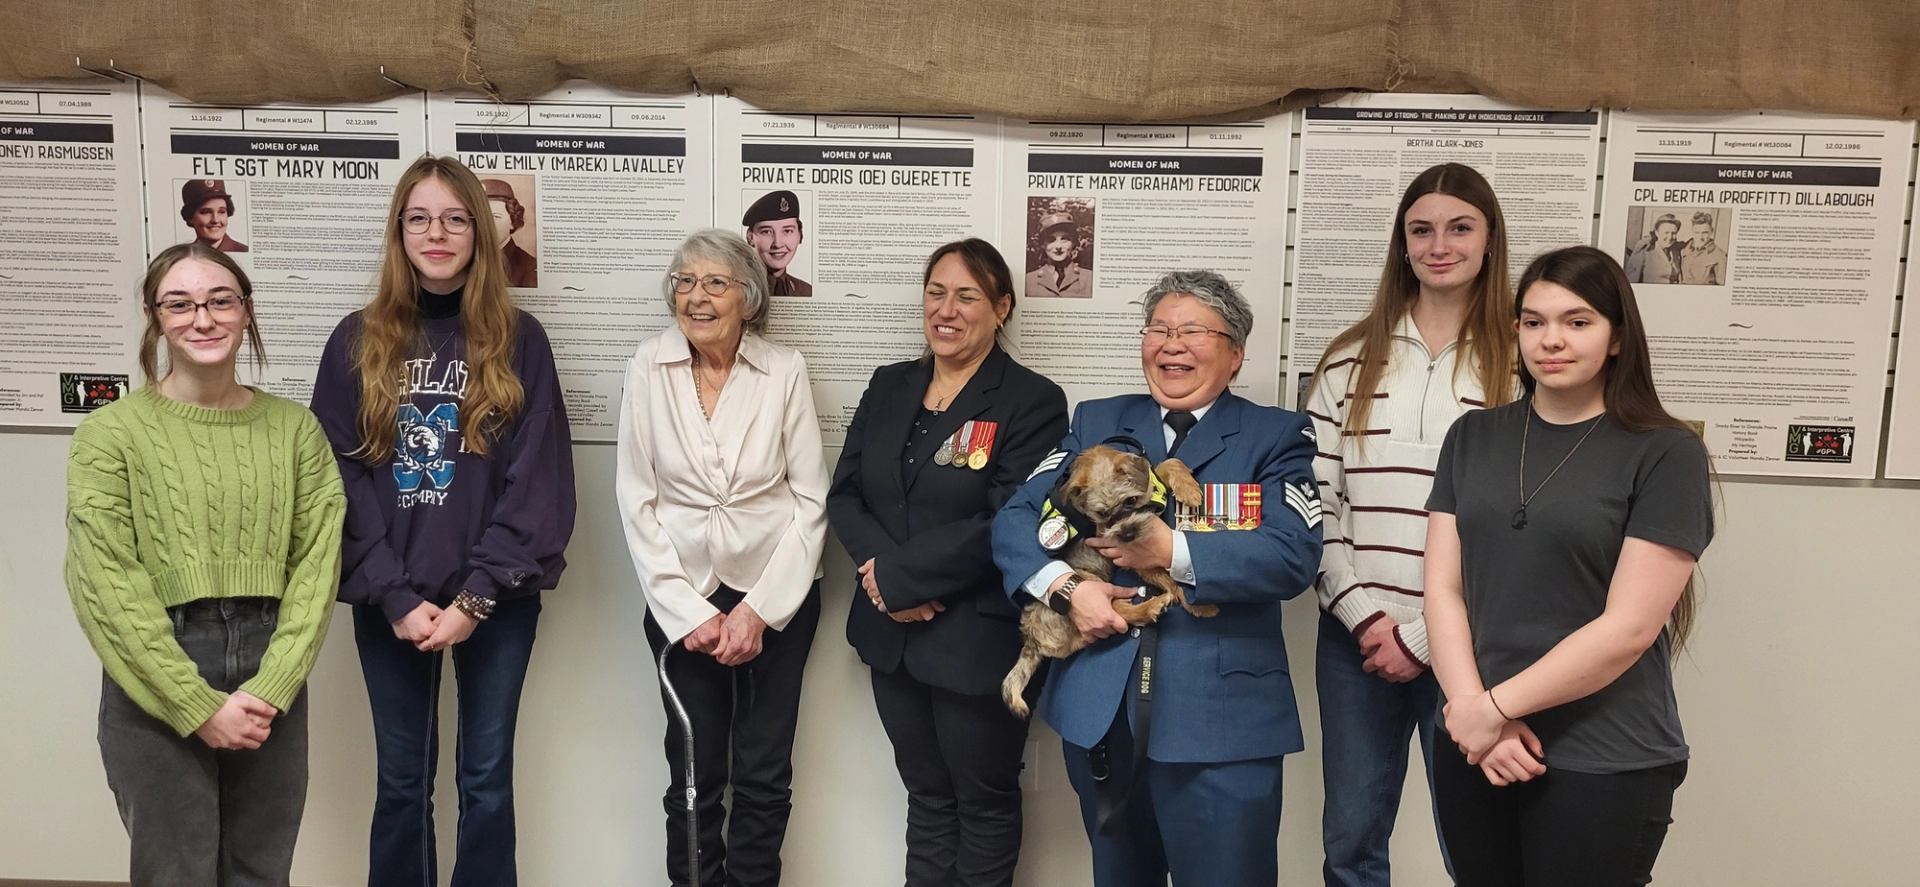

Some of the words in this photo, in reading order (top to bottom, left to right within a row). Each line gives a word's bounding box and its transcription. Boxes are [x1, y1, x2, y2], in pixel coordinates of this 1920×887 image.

[256, 116, 286, 124] Regimental
[1434, 112, 1456, 120] MAKING
[1514, 114, 1544, 122] ADVOCATE
[1, 127, 12, 135] OF
[15, 127, 34, 136] WAR
[1116, 132, 1148, 140] Regimental
[250, 142, 284, 151] WOMEN
[286, 143, 298, 151] OF
[300, 144, 320, 152] WAR
[536, 140, 570, 148] WOMEN
[586, 141, 606, 149] WAR
[1406, 139, 1434, 148] BERTHA
[1436, 140, 1484, 148] CLARK-JONES
[39, 146, 114, 160] RASMUSSEN
[822, 151, 856, 159] WOMEN
[858, 152, 870, 160] OF
[872, 152, 892, 160] WAR
[193, 157, 227, 176] FLT
[235, 158, 268, 177] SGT
[277, 159, 324, 178] MARY
[333, 160, 379, 180] MOON
[504, 154, 546, 170] EMILY
[552, 156, 608, 172] (MAREK)
[613, 158, 684, 174] LAVALLEY
[1109, 160, 1144, 168] WOMEN
[1146, 160, 1158, 169] OF
[1160, 161, 1180, 169] WAR
[742, 167, 806, 184] PRIVATE
[812, 168, 853, 185] DORIS
[860, 169, 886, 186] (OE)
[892, 170, 972, 187] GUERETTE
[1718, 170, 1754, 178] WOMEN
[1756, 170, 1770, 178] OF
[1772, 170, 1793, 180] WAR
[1028, 174, 1084, 190] PRIVATE
[1090, 176, 1126, 190] MARY
[1131, 176, 1194, 192] (GRAHAM)
[1198, 178, 1262, 192] FEDORICK
[1634, 188, 1658, 202] CPL
[1664, 189, 1714, 204] BERTHA
[1720, 190, 1790, 206] (PROFFITT)
[1796, 192, 1875, 207] DILLABOUGH
[1141, 656, 1152, 680] SERVICE
[1140, 681, 1150, 694] DOG
